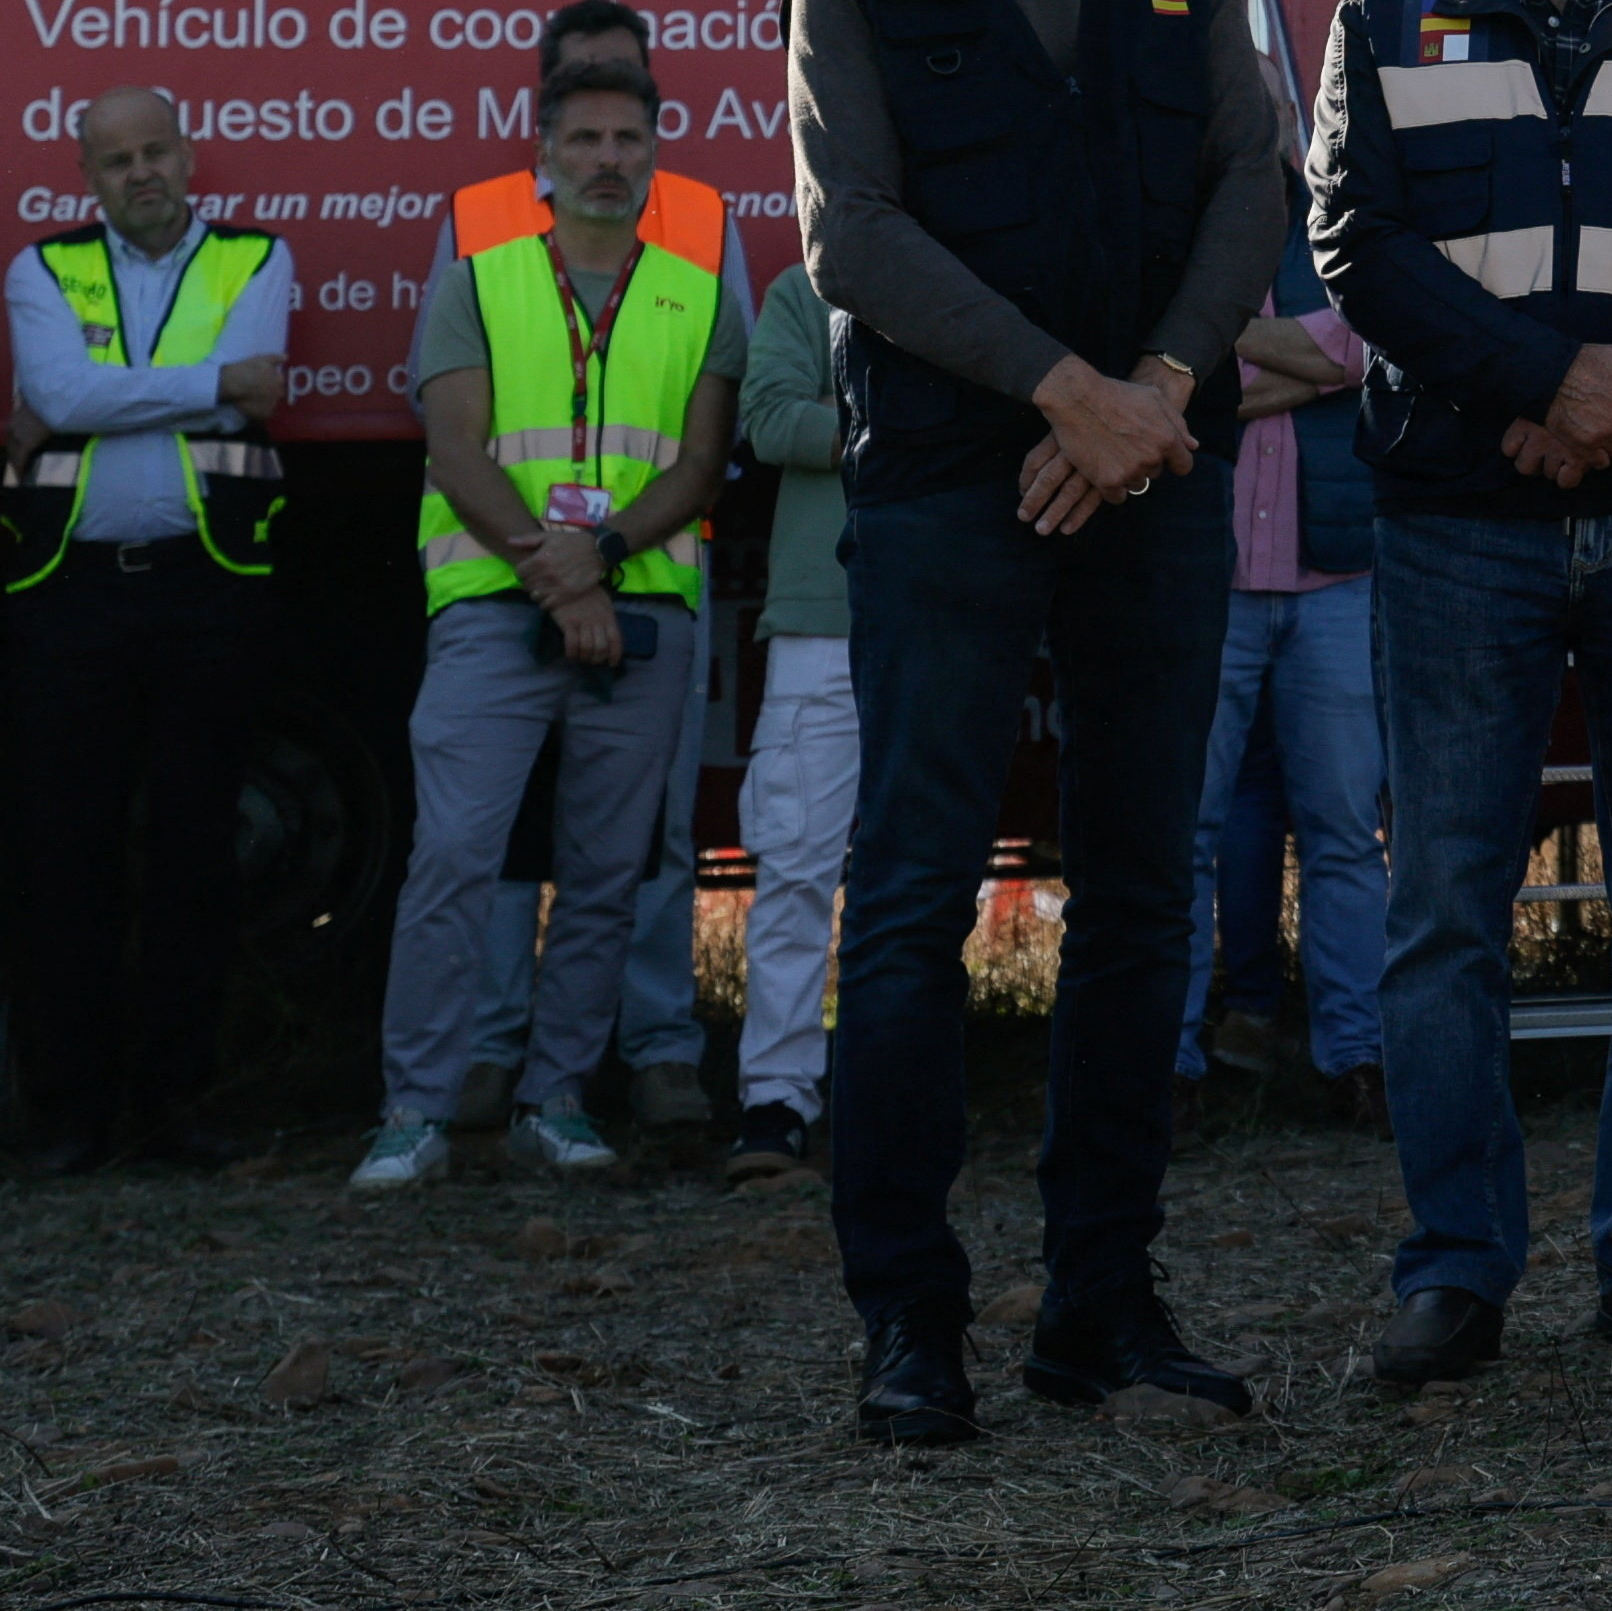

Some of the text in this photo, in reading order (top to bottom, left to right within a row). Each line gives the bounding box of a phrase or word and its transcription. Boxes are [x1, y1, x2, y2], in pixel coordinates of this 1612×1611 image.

[151, 87, 355, 141] uesto
[375, 87, 455, 141] de
[253, 193, 309, 220] un
[319, 186, 443, 227] mejor
[318, 270, 376, 310] de
